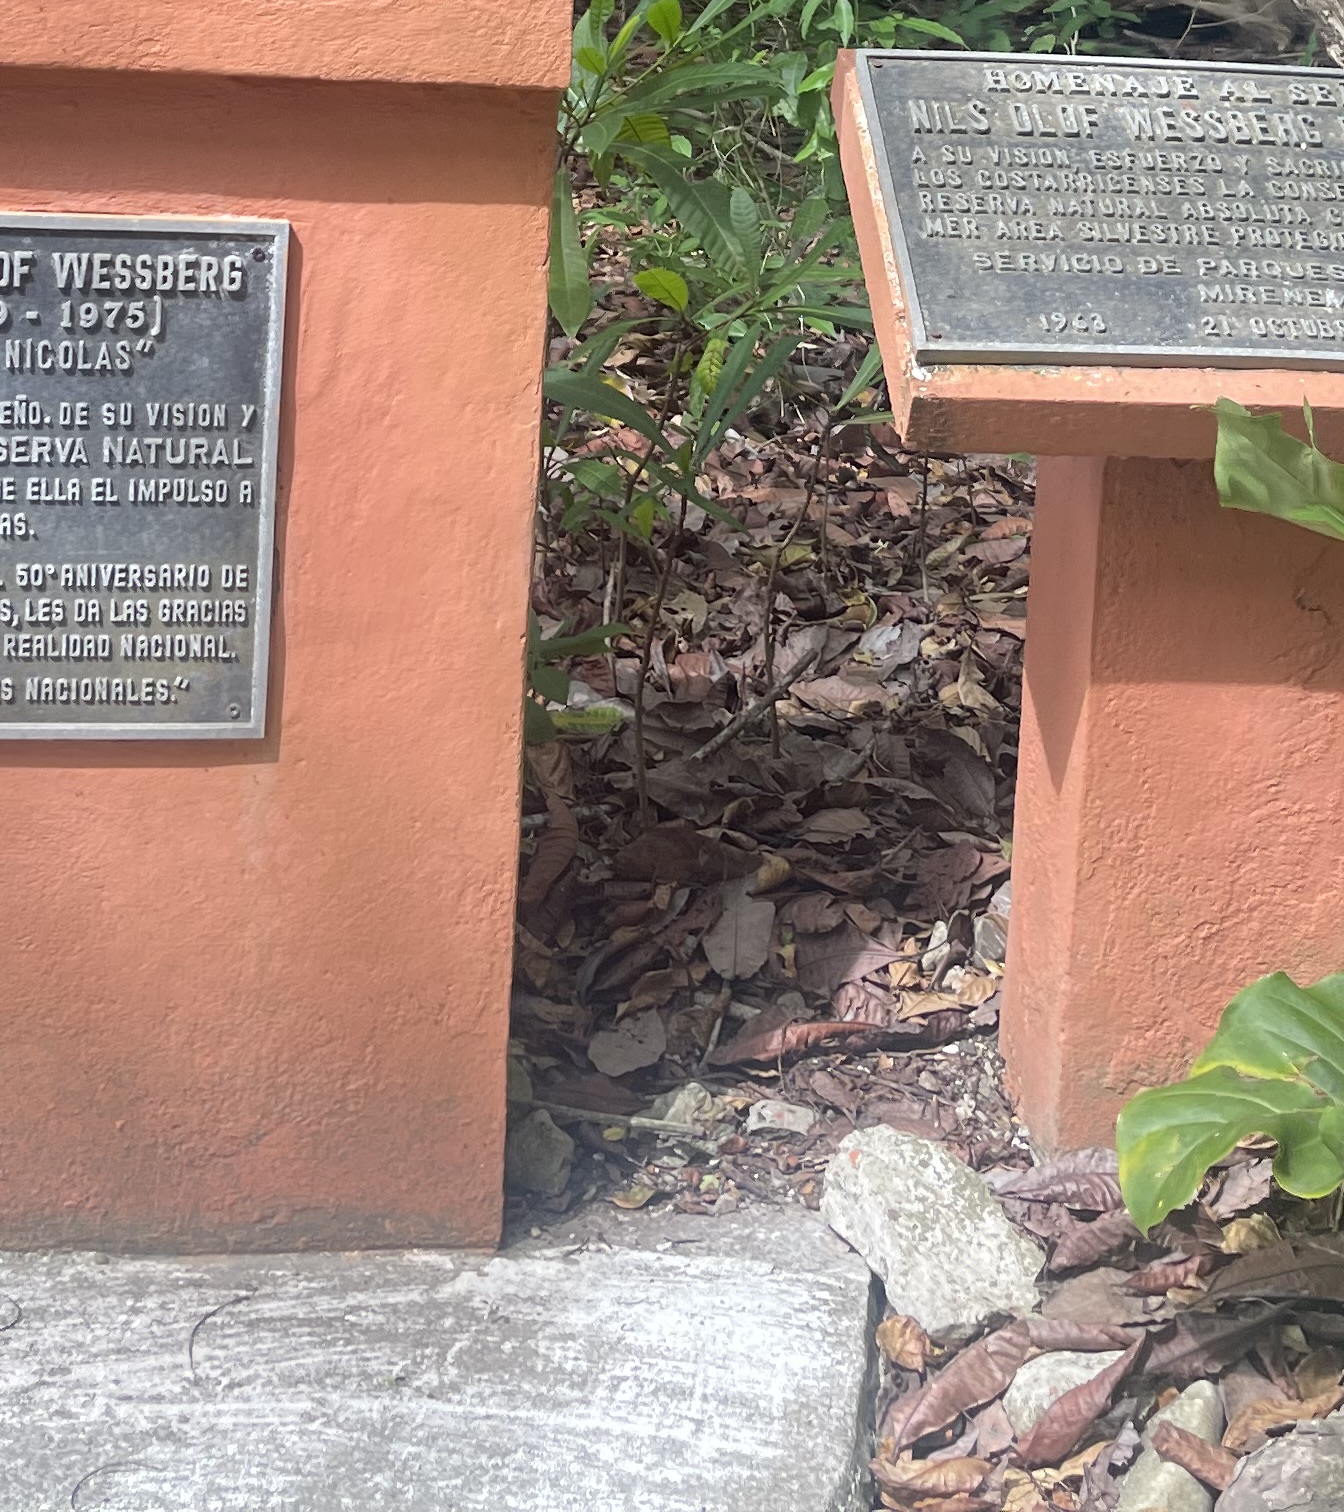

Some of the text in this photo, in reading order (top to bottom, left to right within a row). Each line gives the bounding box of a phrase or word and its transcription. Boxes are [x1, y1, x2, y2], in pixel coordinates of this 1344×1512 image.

[984, 69, 1199, 99] HOMENAJE
[1219, 80, 1272, 104] AL
[908, 99, 991, 134] NILS
[1009, 102, 1099, 139] OLOF
[1121, 106, 1323, 147] WESSBERG
[912, 145, 927, 164] A
[941, 144, 973, 165] SU
[1088, 148, 1223, 174] ESFUERZO
[1234, 154, 1250, 175] Y
[914, 168, 963, 188] LOS
[977, 169, 1206, 196] COSTARRICENSES
[1218, 179, 1255, 198] LA
[918, 191, 1036, 216] RESERVA
[1049, 196, 1168, 220] NATURAL
[1182, 201, 1313, 225] ABSOLUTA
[923, 217, 980, 239] MER
[996, 219, 1065, 241] AREA
[1077, 221, 1220, 246] SILVESTRE
[51, 251, 244, 292] WESSBERG
[973, 252, 1124, 274] SERVICIO
[1138, 256, 1182, 275] DE
[1040, 312, 1107, 334] 1963
[59, 402, 90, 426] DE
[102, 402, 133, 426] SU
[146, 402, 226, 427] VISION
[241, 404, 255, 428] Y
[103, 436, 253, 465] NATURAL
[26, 477, 80, 501] ELLA
[91, 478, 118, 502] EL
[128, 478, 228, 502] IMPULSO
[239, 480, 252, 503] A
[60, 563, 210, 588] ANIVERSARIO
[221, 564, 248, 588] DE
[24, 598, 64, 622] LES
[74, 598, 100, 622] DA
[109, 598, 148, 622] LAS
[158, 598, 247, 622] GRACIAS
[4, 633, 110, 657] REALIDAD
[120, 634, 237, 658] NACIONAL.
